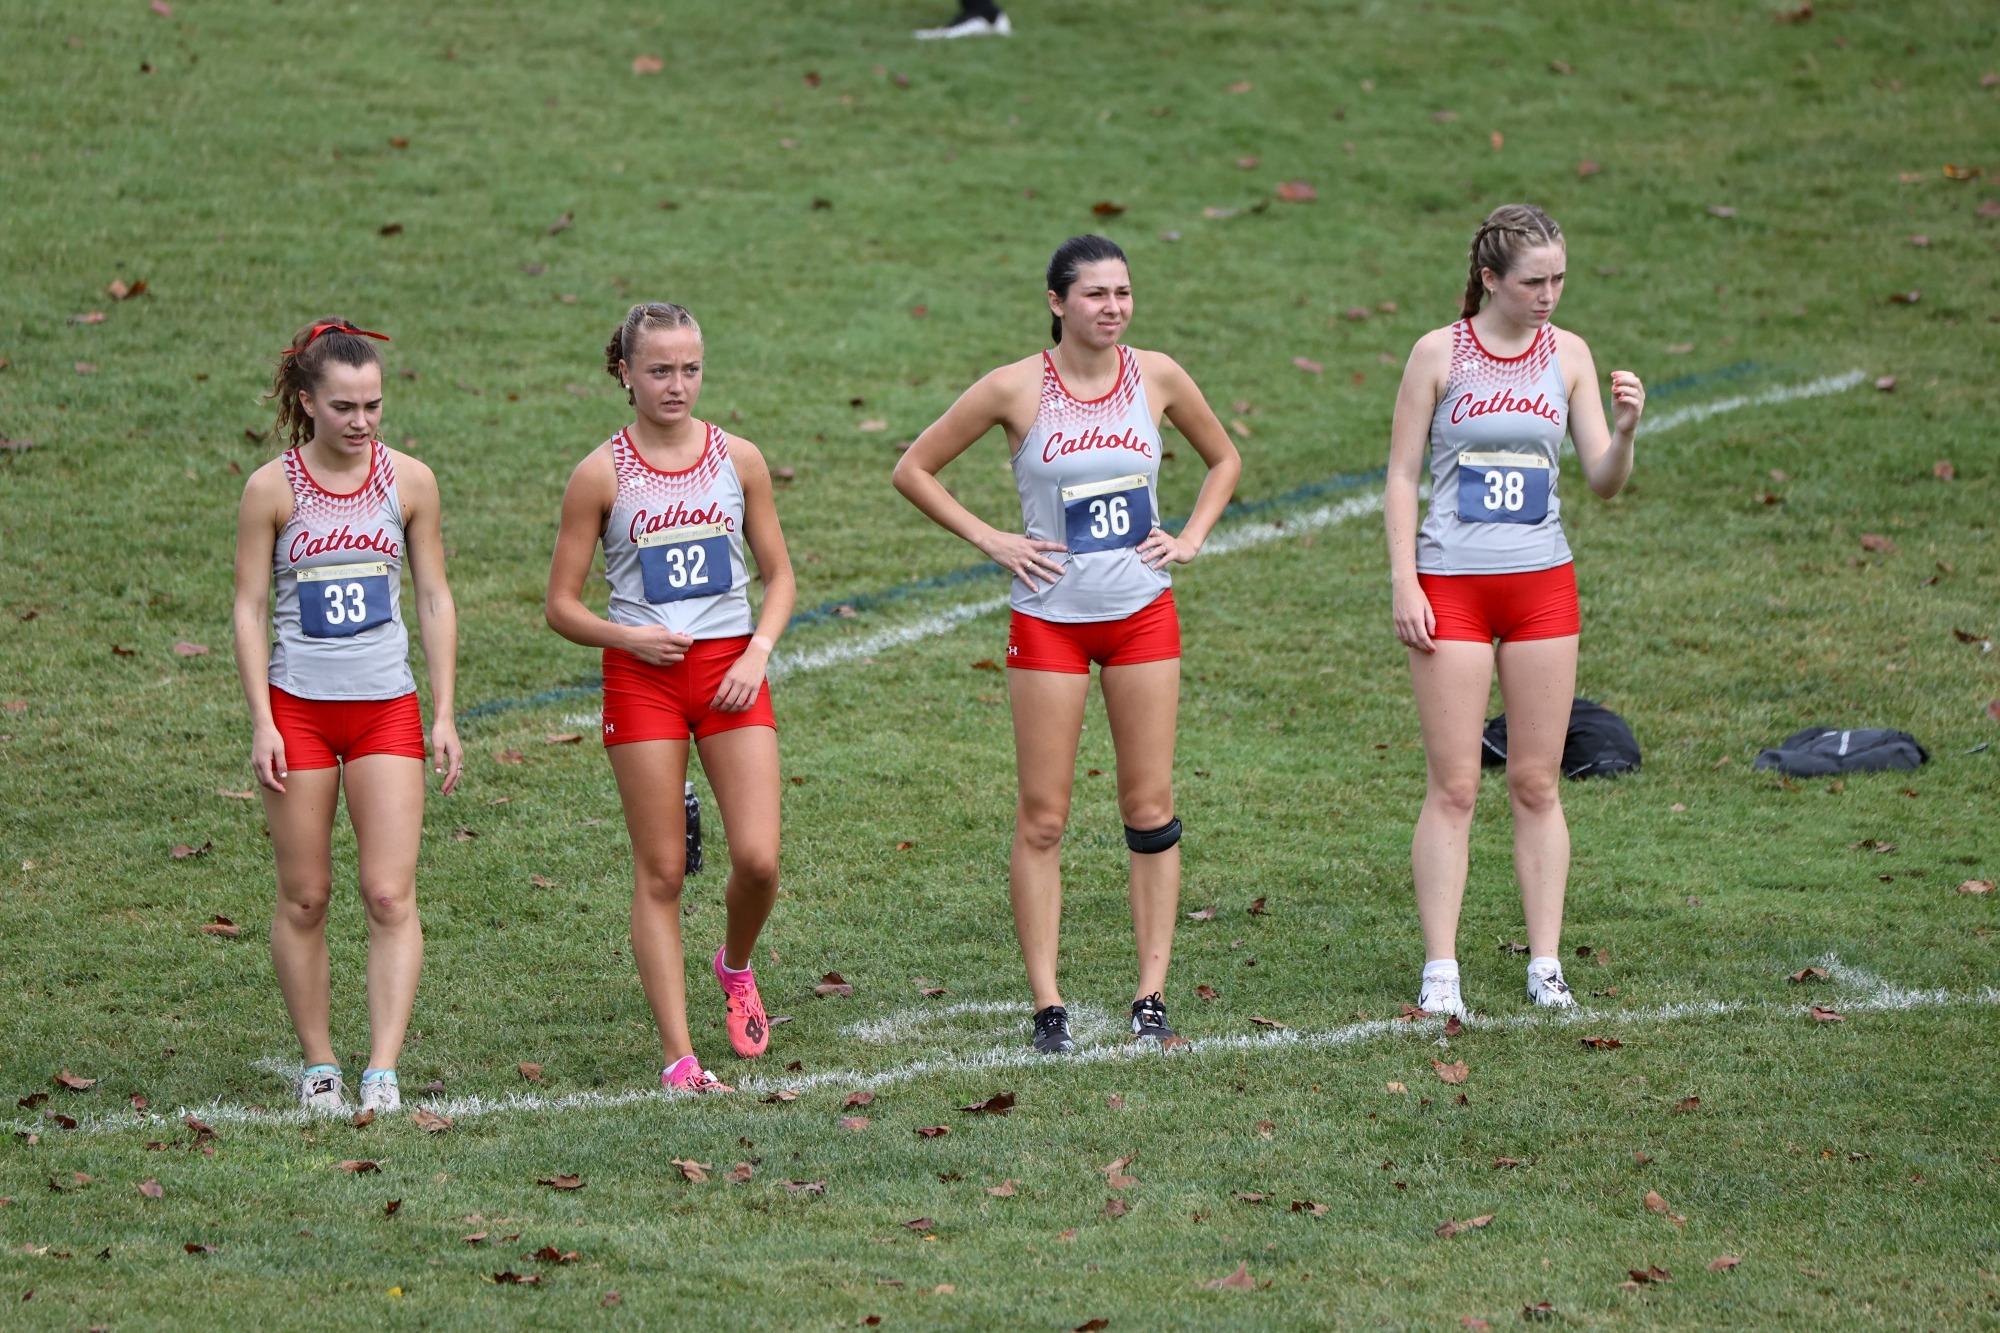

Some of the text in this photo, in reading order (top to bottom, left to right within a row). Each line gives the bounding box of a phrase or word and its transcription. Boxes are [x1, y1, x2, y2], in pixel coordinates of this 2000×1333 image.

[1451, 387, 1560, 426] Catholic
[1042, 425, 1153, 464] Catholic
[1483, 470, 1526, 511] 38
[629, 500, 735, 544] Catholic
[1088, 496, 1131, 539] 36
[288, 524, 399, 564] Catholic
[665, 544, 709, 588] 32
[324, 582, 367, 625] 33
